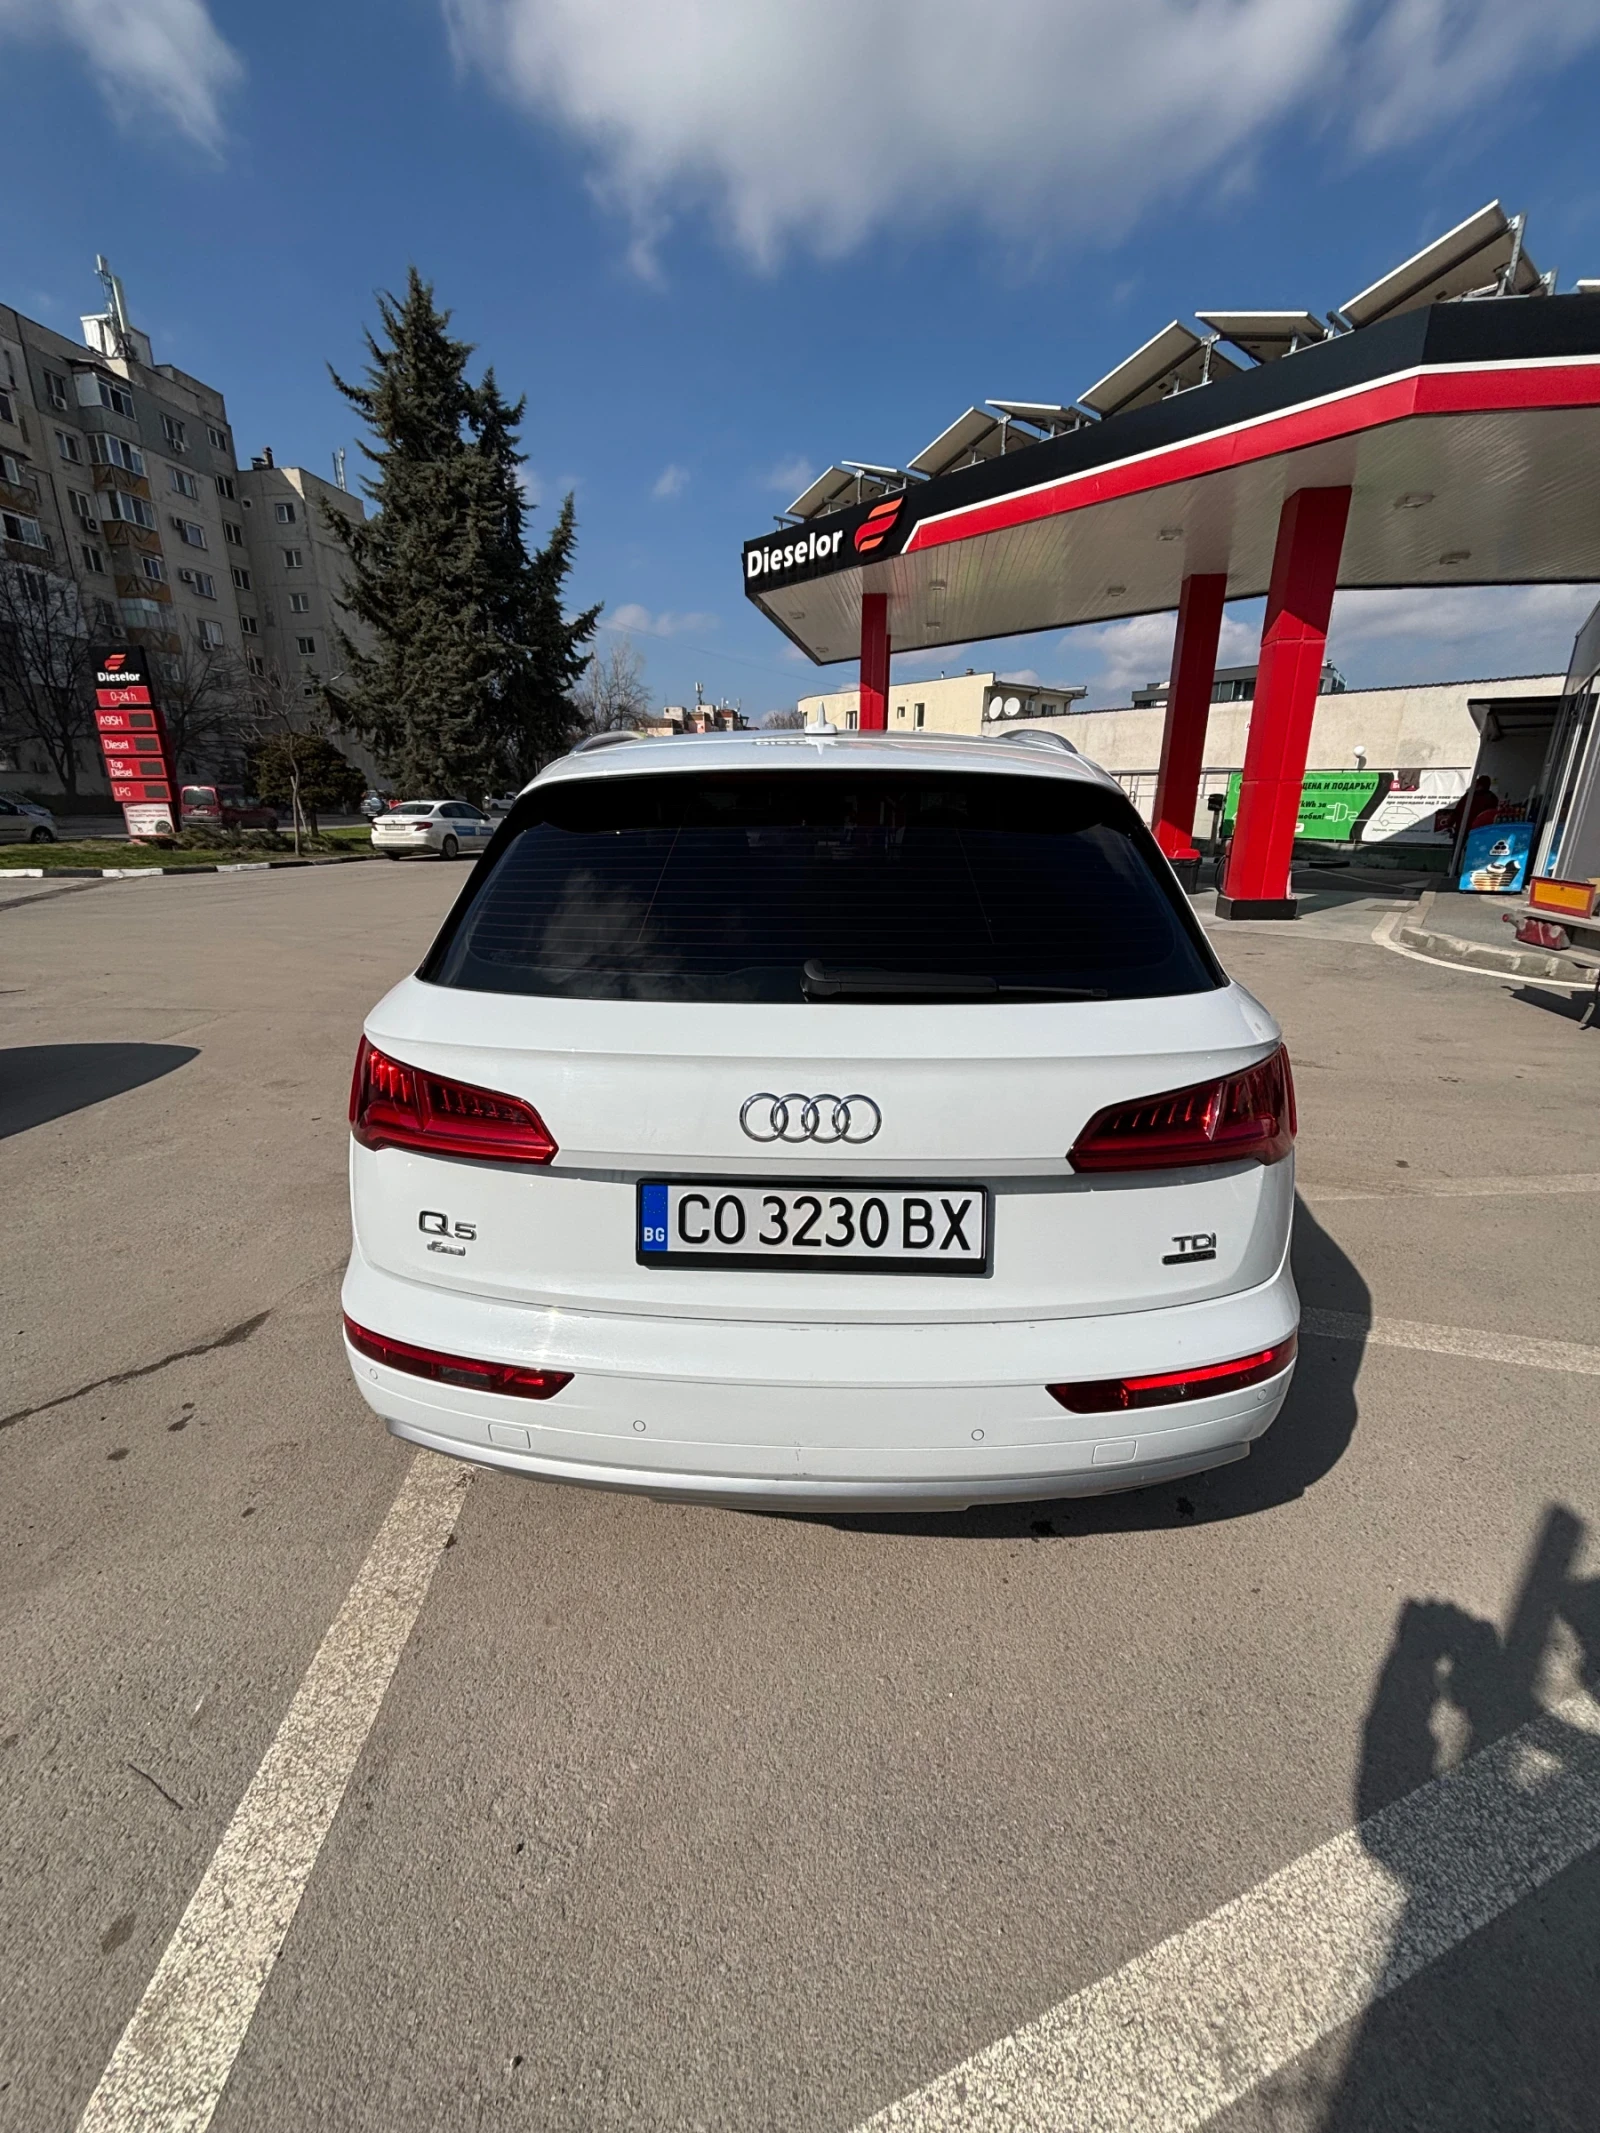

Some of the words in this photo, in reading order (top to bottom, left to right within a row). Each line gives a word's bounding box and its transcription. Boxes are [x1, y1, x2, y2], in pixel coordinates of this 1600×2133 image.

[747, 529, 844, 579] Dieselor
[97, 672, 140, 682] Dieselor
[110, 691, 129, 701] 0-24
[130, 692, 137, 701] h
[104, 739, 129, 750] Diesel
[110, 759, 123, 769] Top
[110, 768, 133, 778] Diesel
[115, 786, 131, 797] LPG
[1302, 782, 1322, 791] ЦЕНА
[1323, 782, 1330, 790] И
[1331, 782, 1376, 791] ПОДАРЪК!
[1298, 812, 1325, 820] мобил!
[418, 1210, 478, 1242] Q5
[676, 1193, 746, 1245] CO
[758, 1195, 890, 1250] 3230
[902, 1197, 972, 1252] BX
[643, 1226, 665, 1243] BG
[1172, 1231, 1217, 1252] TDI
